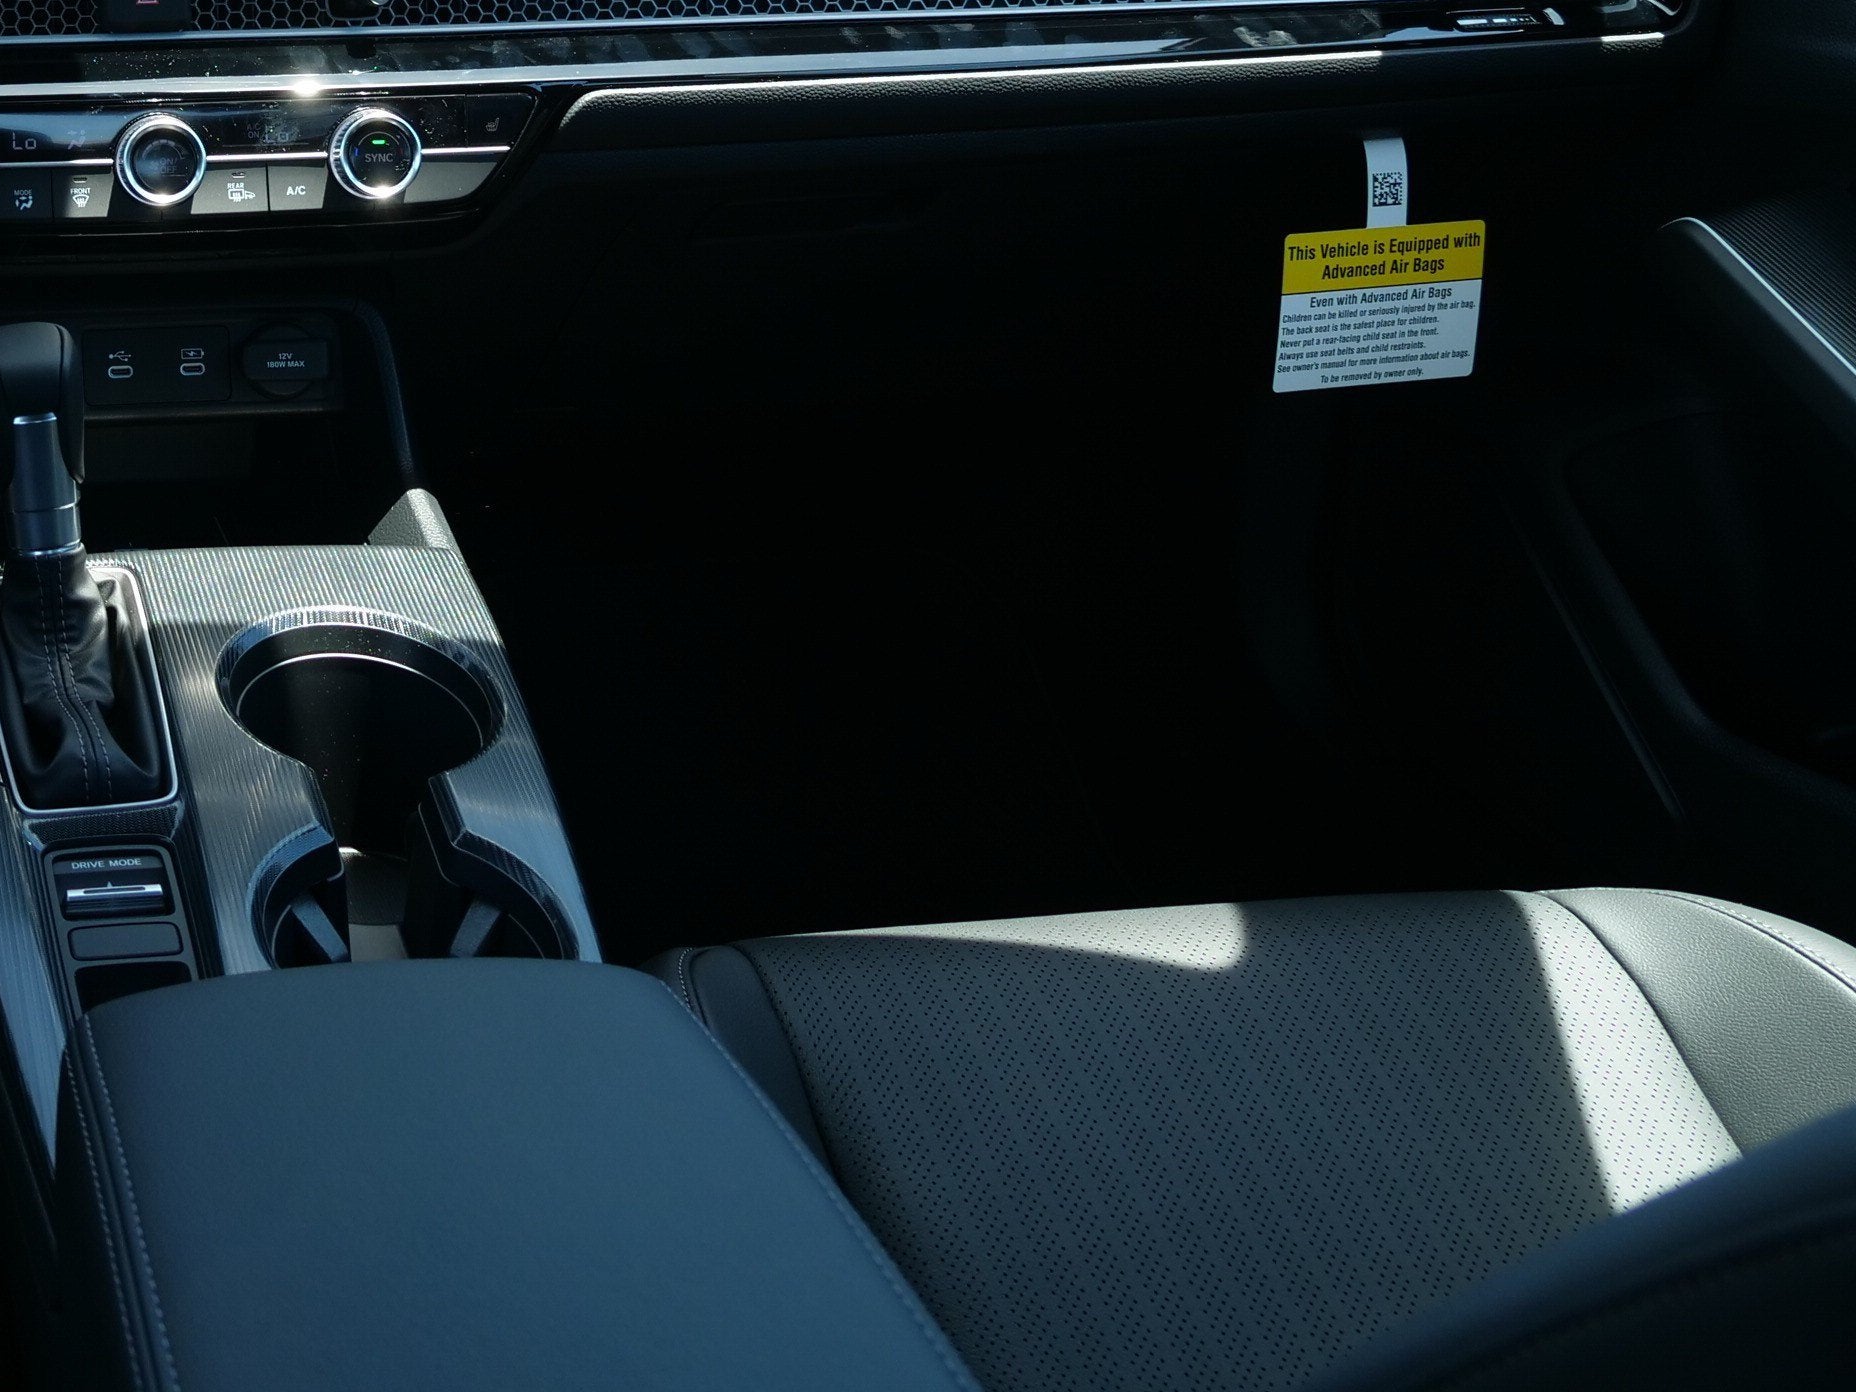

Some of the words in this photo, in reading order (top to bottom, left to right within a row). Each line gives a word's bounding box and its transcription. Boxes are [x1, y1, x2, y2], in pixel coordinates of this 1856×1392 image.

[364, 153, 394, 164] SYNC
[161, 165, 177, 174] OFF
[286, 186, 306, 196] A/C
[1288, 245, 1316, 261] This
[1321, 241, 1369, 259] Vehicle
[1373, 240, 1385, 254] is
[1389, 235, 1449, 253] Equipped
[1454, 233, 1480, 248] with
[1322, 260, 1385, 280] Advanced
[1389, 259, 1409, 273] Air
[1413, 257, 1445, 274] Bags
[1310, 297, 1334, 308] Even
[1337, 294, 1357, 305] with
[1360, 290, 1408, 304] Advanced
[1411, 289, 1426, 299] Air
[1429, 287, 1452, 299] Bags
[1283, 313, 1312, 323] Children
[1328, 311, 1336, 319] be
[1338, 309, 1358, 318] killed
[1368, 305, 1400, 316] seriously
[1401, 303, 1425, 314] injured
[1428, 303, 1435, 311] by
[1437, 302, 1448, 310] the
[1449, 301, 1460, 309] air
[1461, 301, 1475, 309] bag.
[1281, 327, 1295, 336] The
[1297, 326, 1313, 334] back
[1314, 325, 1330, 333] seat
[1353, 321, 1374, 329] safest
[1376, 319, 1395, 328] place
[1397, 318, 1407, 326] for
[1409, 316, 1439, 325] children.
[1280, 339, 1303, 348] Never
[1303, 338, 1314, 347] put
[1322, 334, 1361, 344] rear-facing
[1363, 332, 1380, 341] child
[1381, 331, 1397, 339] seat
[1399, 330, 1405, 338] in
[1407, 329, 1418, 337] the
[1420, 328, 1439, 336] front.
[277, 352, 294, 360] 12V
[1279, 352, 1303, 361] Always
[1320, 349, 1335, 357] seat
[1337, 347, 1355, 355] belts
[1356, 345, 1369, 354] and
[1371, 344, 1389, 352] child
[1390, 341, 1425, 351] restraints.
[266, 360, 286, 369] 180W
[287, 359, 306, 368] MAX
[1277, 365, 1290, 373] See
[1292, 362, 1319, 371] owner's
[1321, 359, 1347, 369] manual
[1348, 359, 1358, 367] for
[1379, 354, 1418, 364] information
[1419, 352, 1439, 360] about
[1452, 350, 1470, 359] bags.
[1321, 375, 1328, 383] To
[1330, 374, 1339, 382] be
[1341, 372, 1371, 381] removed
[1373, 371, 1382, 380] by
[1384, 370, 1405, 378] owner
[1407, 367, 1423, 376] only.
[71, 860, 105, 870] DRIVE
[109, 858, 143, 867] MODE
